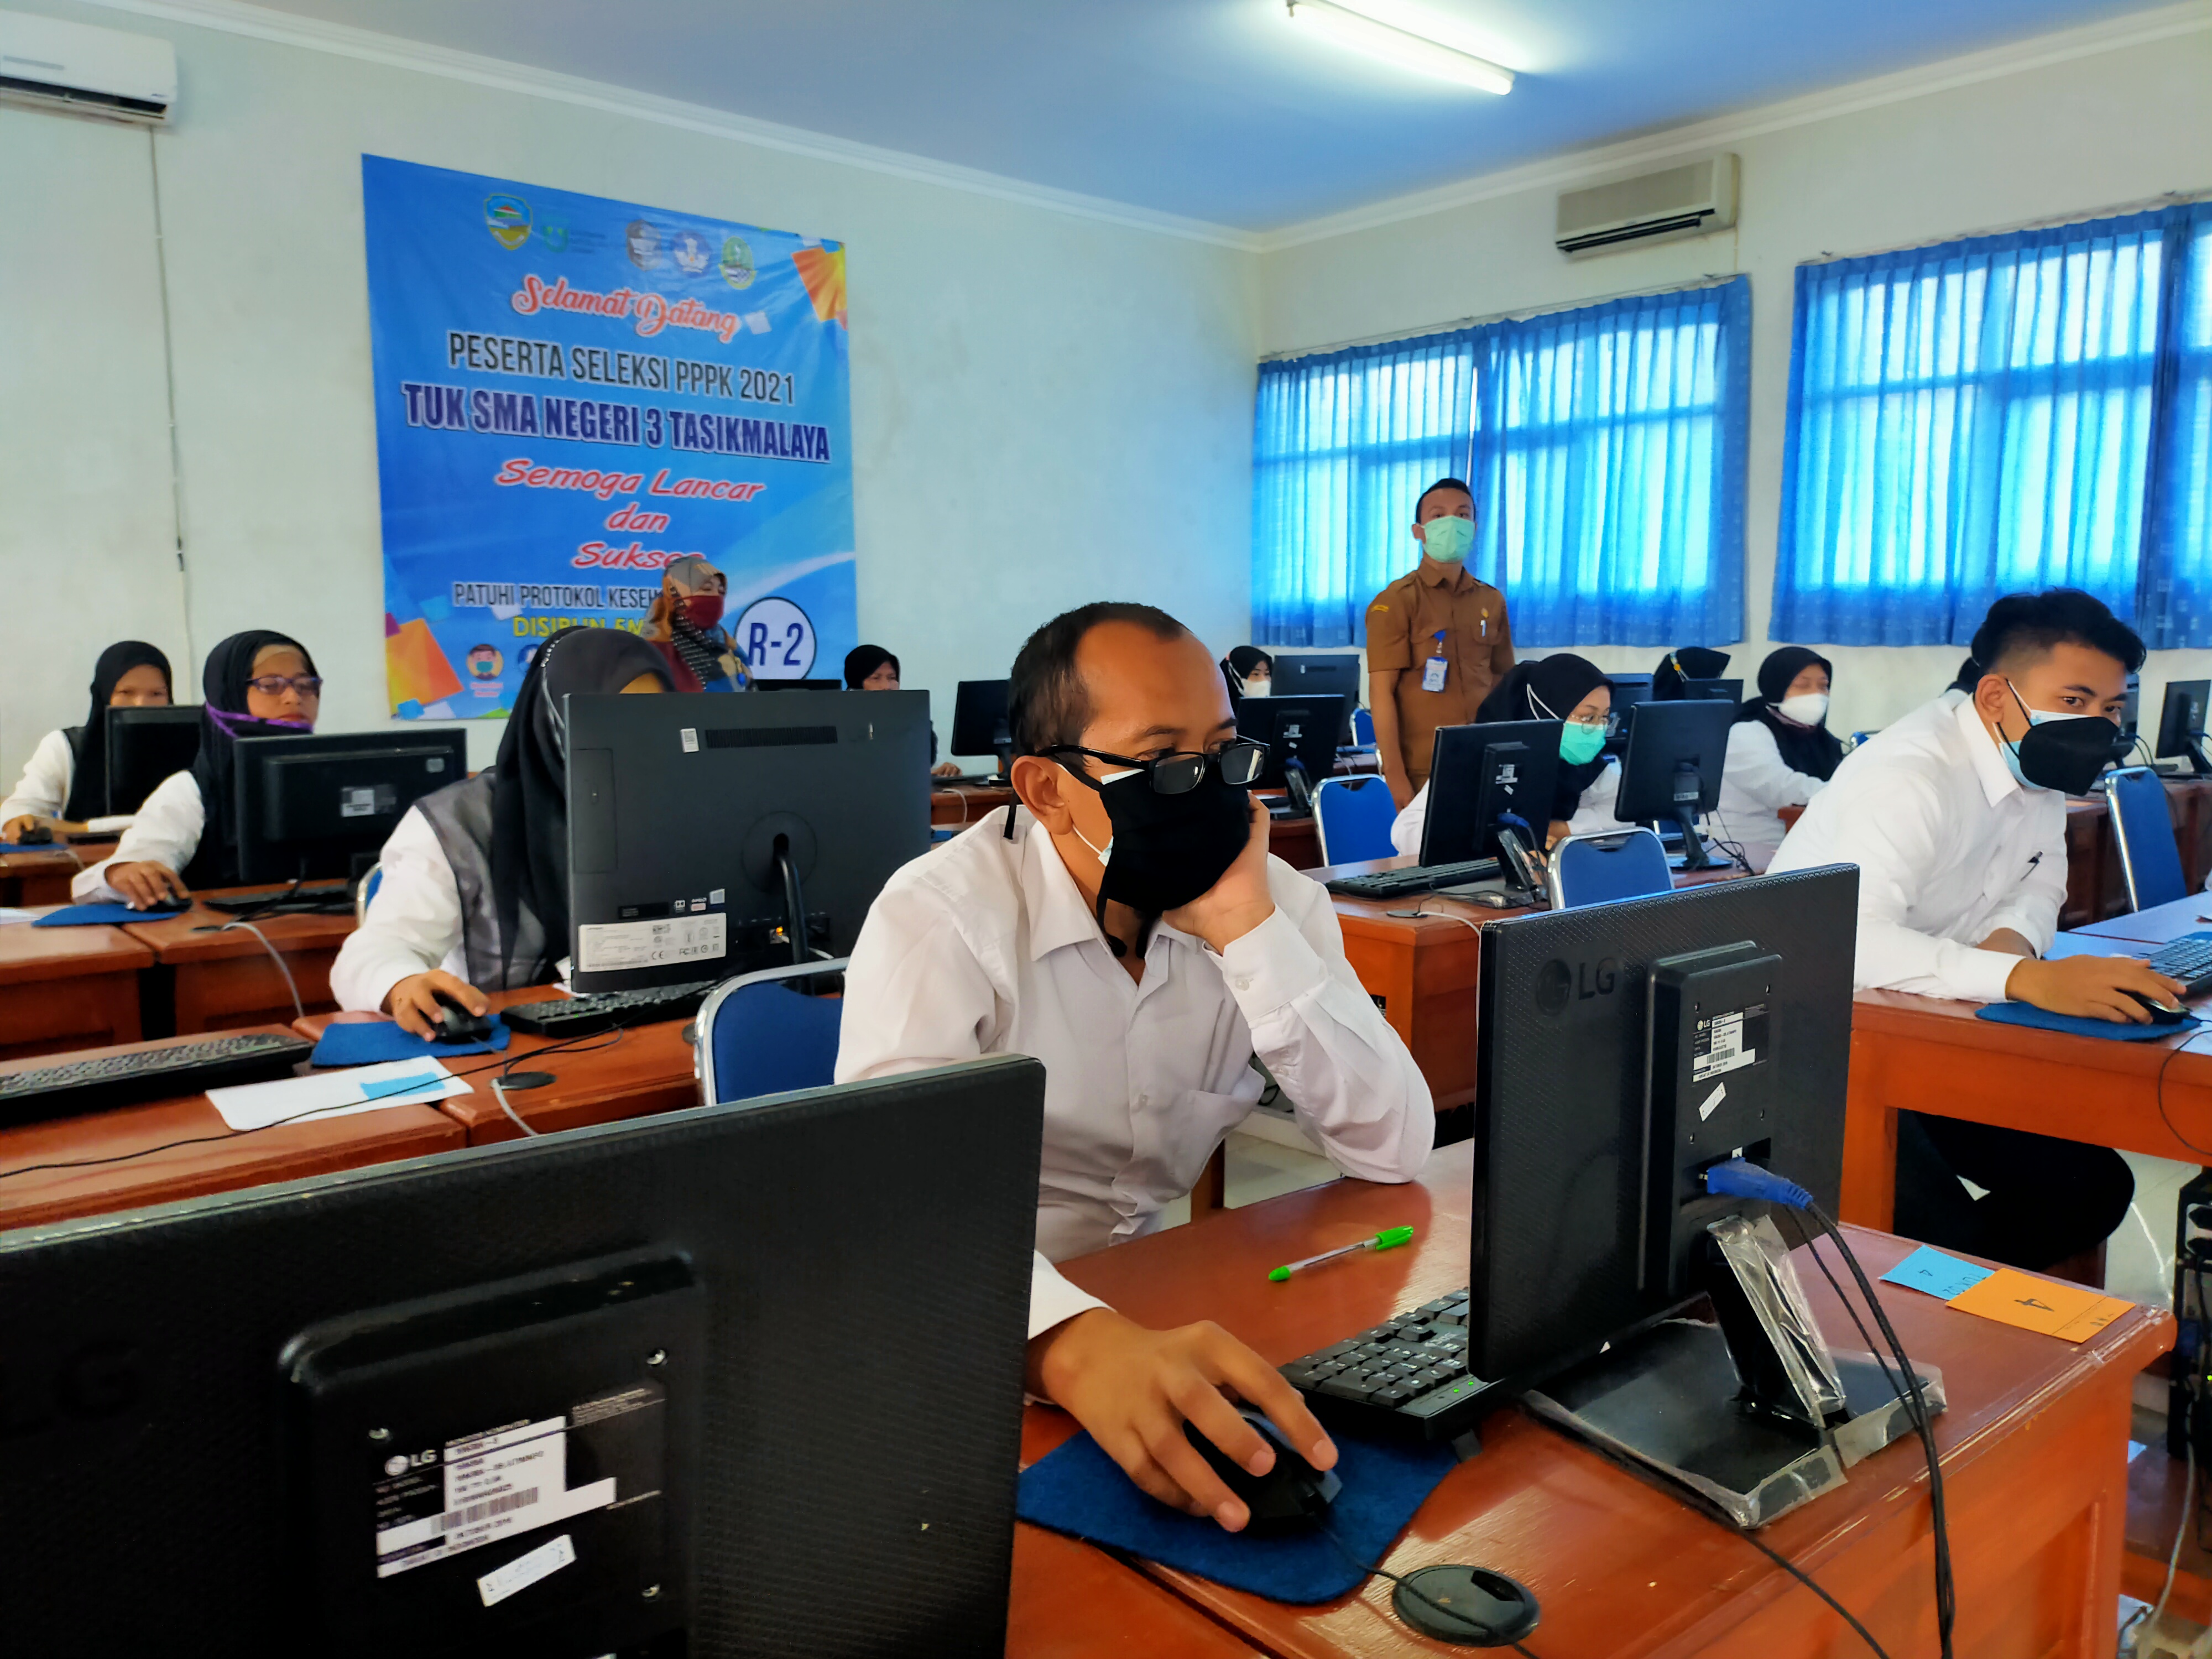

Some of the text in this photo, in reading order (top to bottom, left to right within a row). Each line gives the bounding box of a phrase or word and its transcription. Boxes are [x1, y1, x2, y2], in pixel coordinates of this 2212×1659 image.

[512, 275, 739, 342] Selamat Datang
[450, 332, 793, 404] PESERTA SELEKSI PPPK 2021
[403, 383, 831, 462] TUK SMA NEGERI 3 TASIKMALAYA
[497, 458, 765, 501] Semoga Lancar
[606, 502, 670, 531] dan
[573, 541, 705, 568] Suks
[454, 583, 662, 608] PATUHI PROTOKOL KESEH
[748, 623, 804, 666] R-2
[1578, 957, 1616, 1000] LG
[1703, 1019, 1710, 1027] LG
[2013, 1298, 2055, 1312] 4
[410, 1449, 437, 1467] LG
